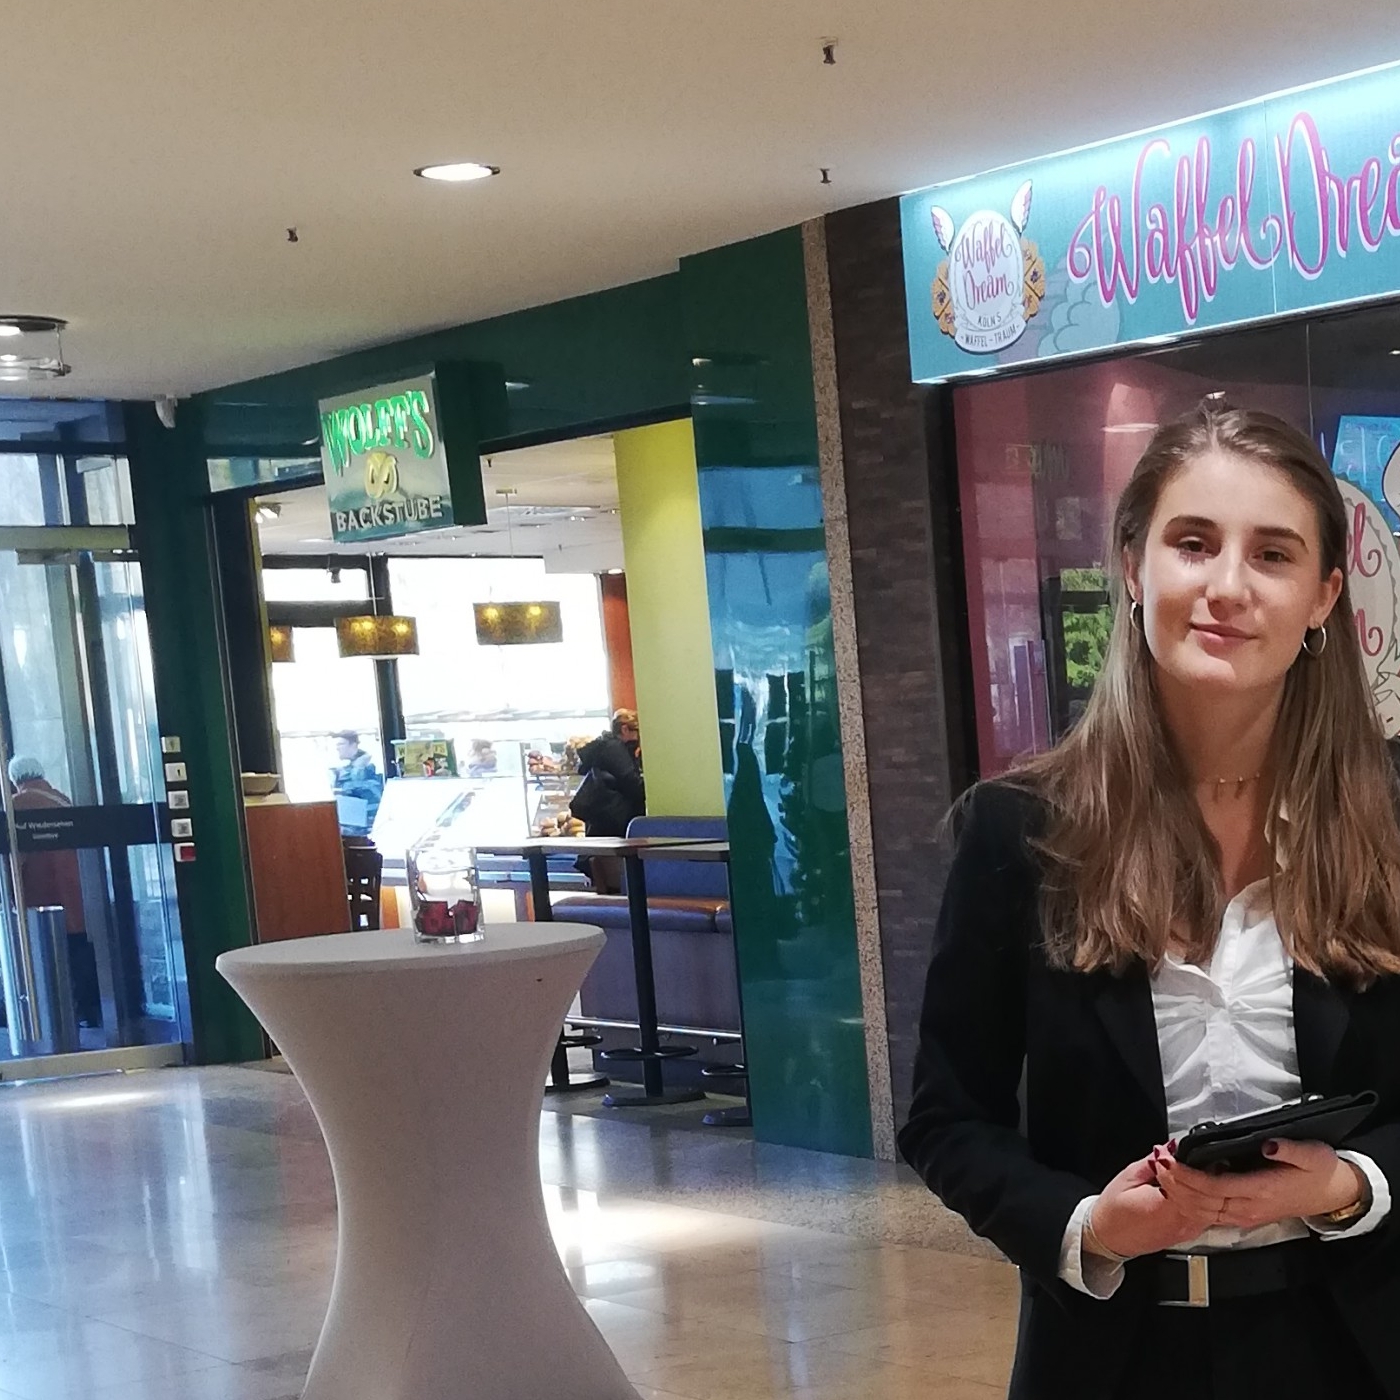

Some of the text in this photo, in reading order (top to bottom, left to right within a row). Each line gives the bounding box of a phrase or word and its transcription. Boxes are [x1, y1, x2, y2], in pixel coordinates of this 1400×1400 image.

[955, 220, 1012, 274] Waffel
[1067, 134, 1282, 325] Waffel
[963, 270, 1015, 310] Dream
[335, 495, 443, 532] BACKSTUBE
